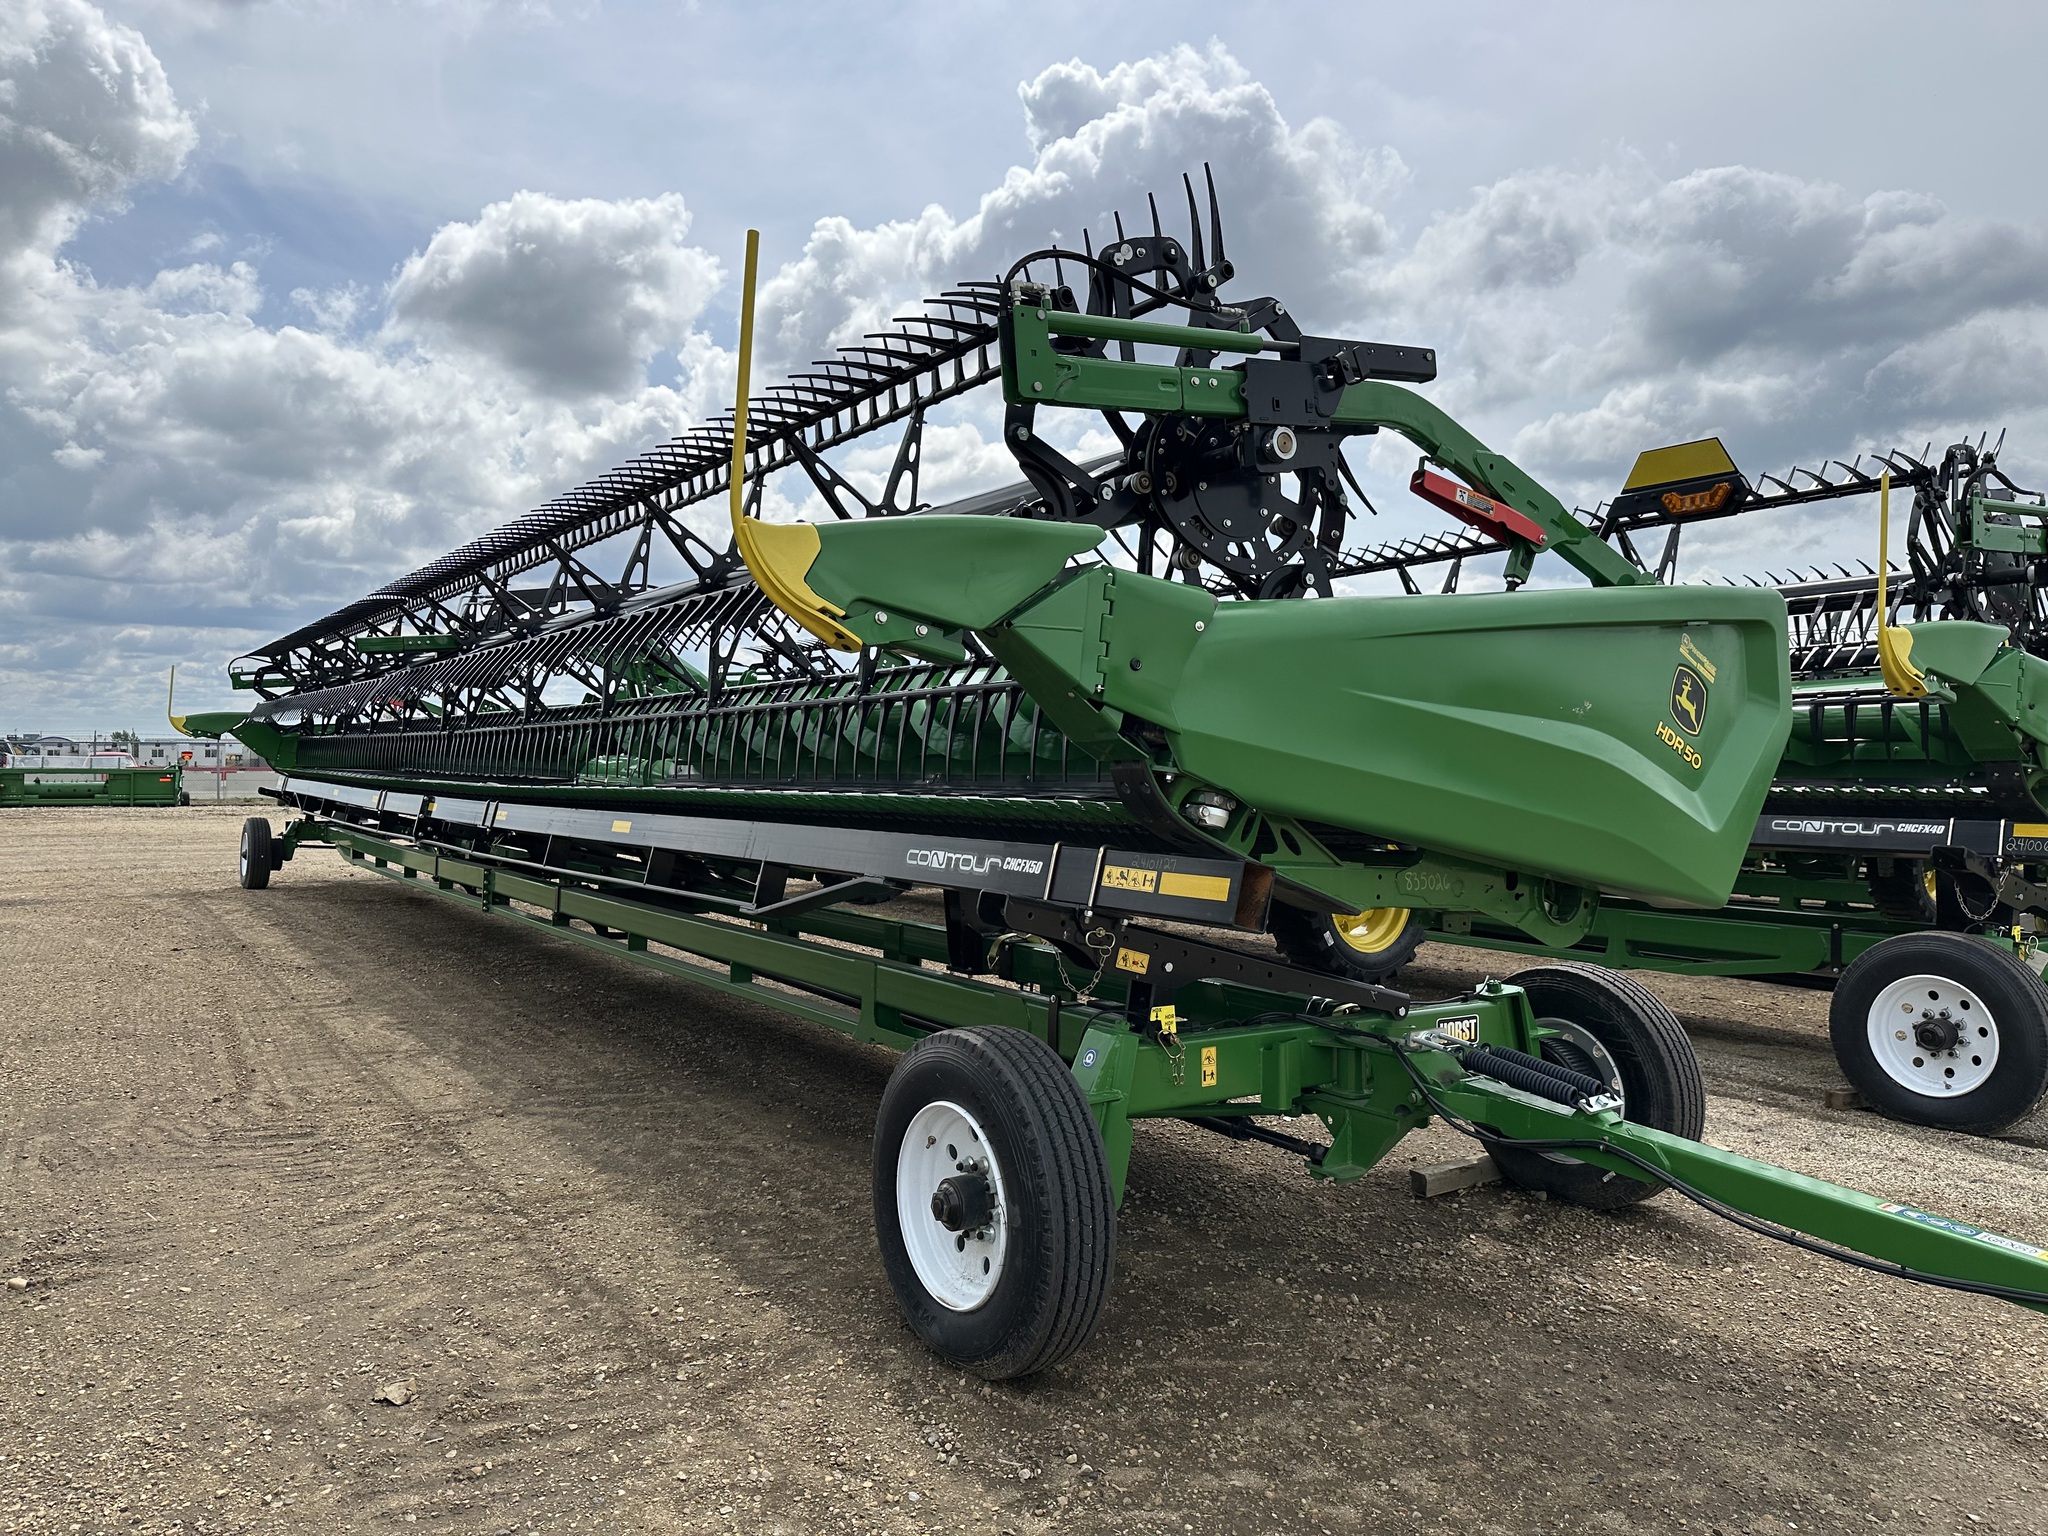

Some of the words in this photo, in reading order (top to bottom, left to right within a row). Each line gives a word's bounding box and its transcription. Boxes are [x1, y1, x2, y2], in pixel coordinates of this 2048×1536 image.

[1655, 720, 1685, 755] HDR
[1683, 746, 1702, 769] 50
[1896, 823, 1946, 835] CHCFX40
[1002, 856, 1044, 875] CHCFX50
[1404, 871, 1451, 892] 835026
